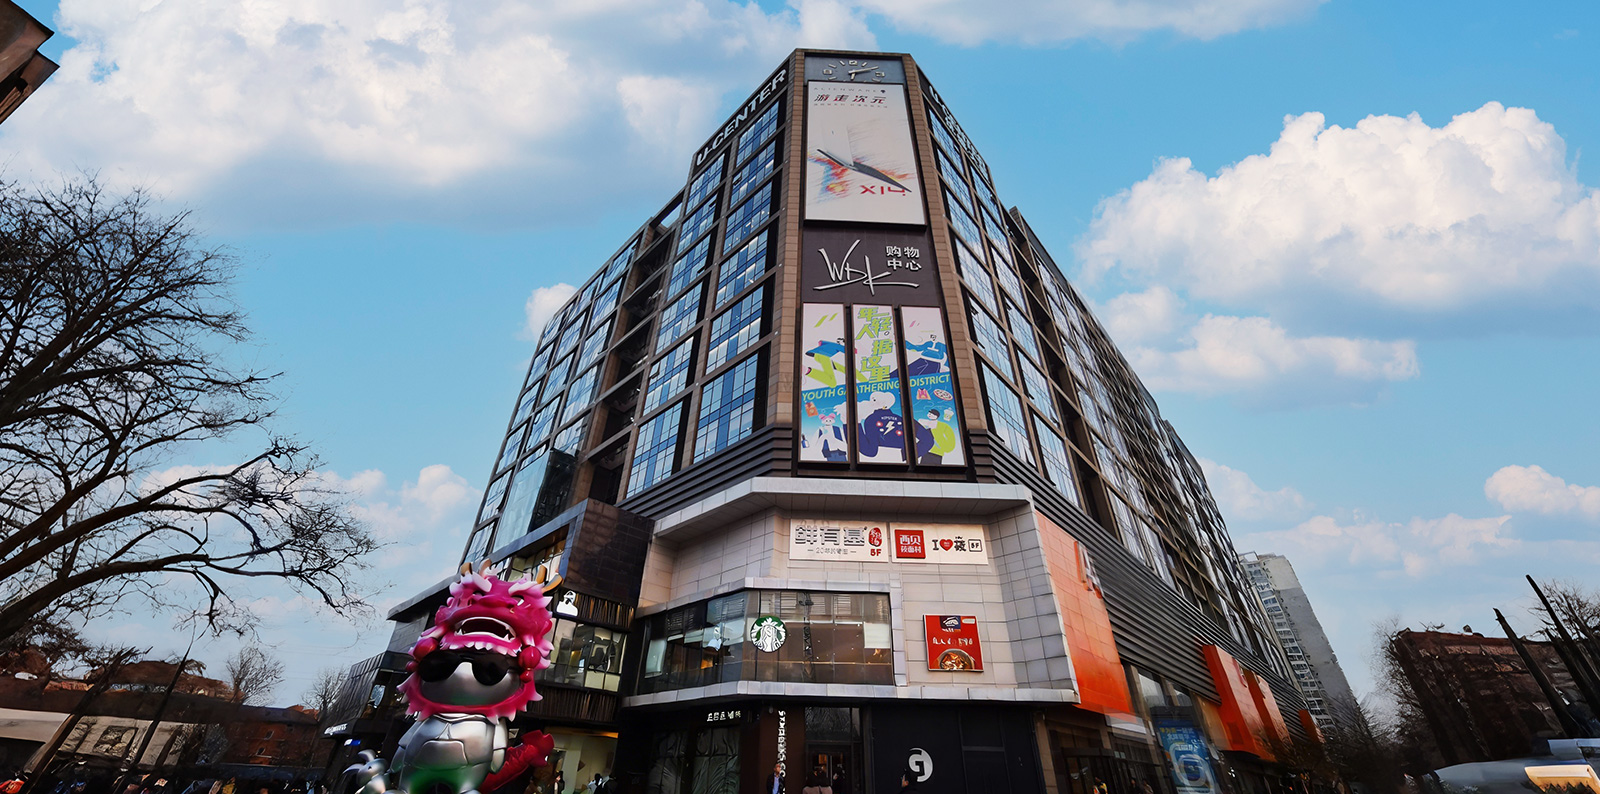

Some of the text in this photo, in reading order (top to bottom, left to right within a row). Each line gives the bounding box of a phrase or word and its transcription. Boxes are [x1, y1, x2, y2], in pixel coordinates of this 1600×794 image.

[696, 68, 787, 167] U-CENTER
[886, 245, 920, 258] 购物
[887, 258, 922, 271] 中心
[802, 387, 836, 402] YOUTH
[909, 374, 951, 387] DISTRICT
[899, 534, 921, 545] 西贝
